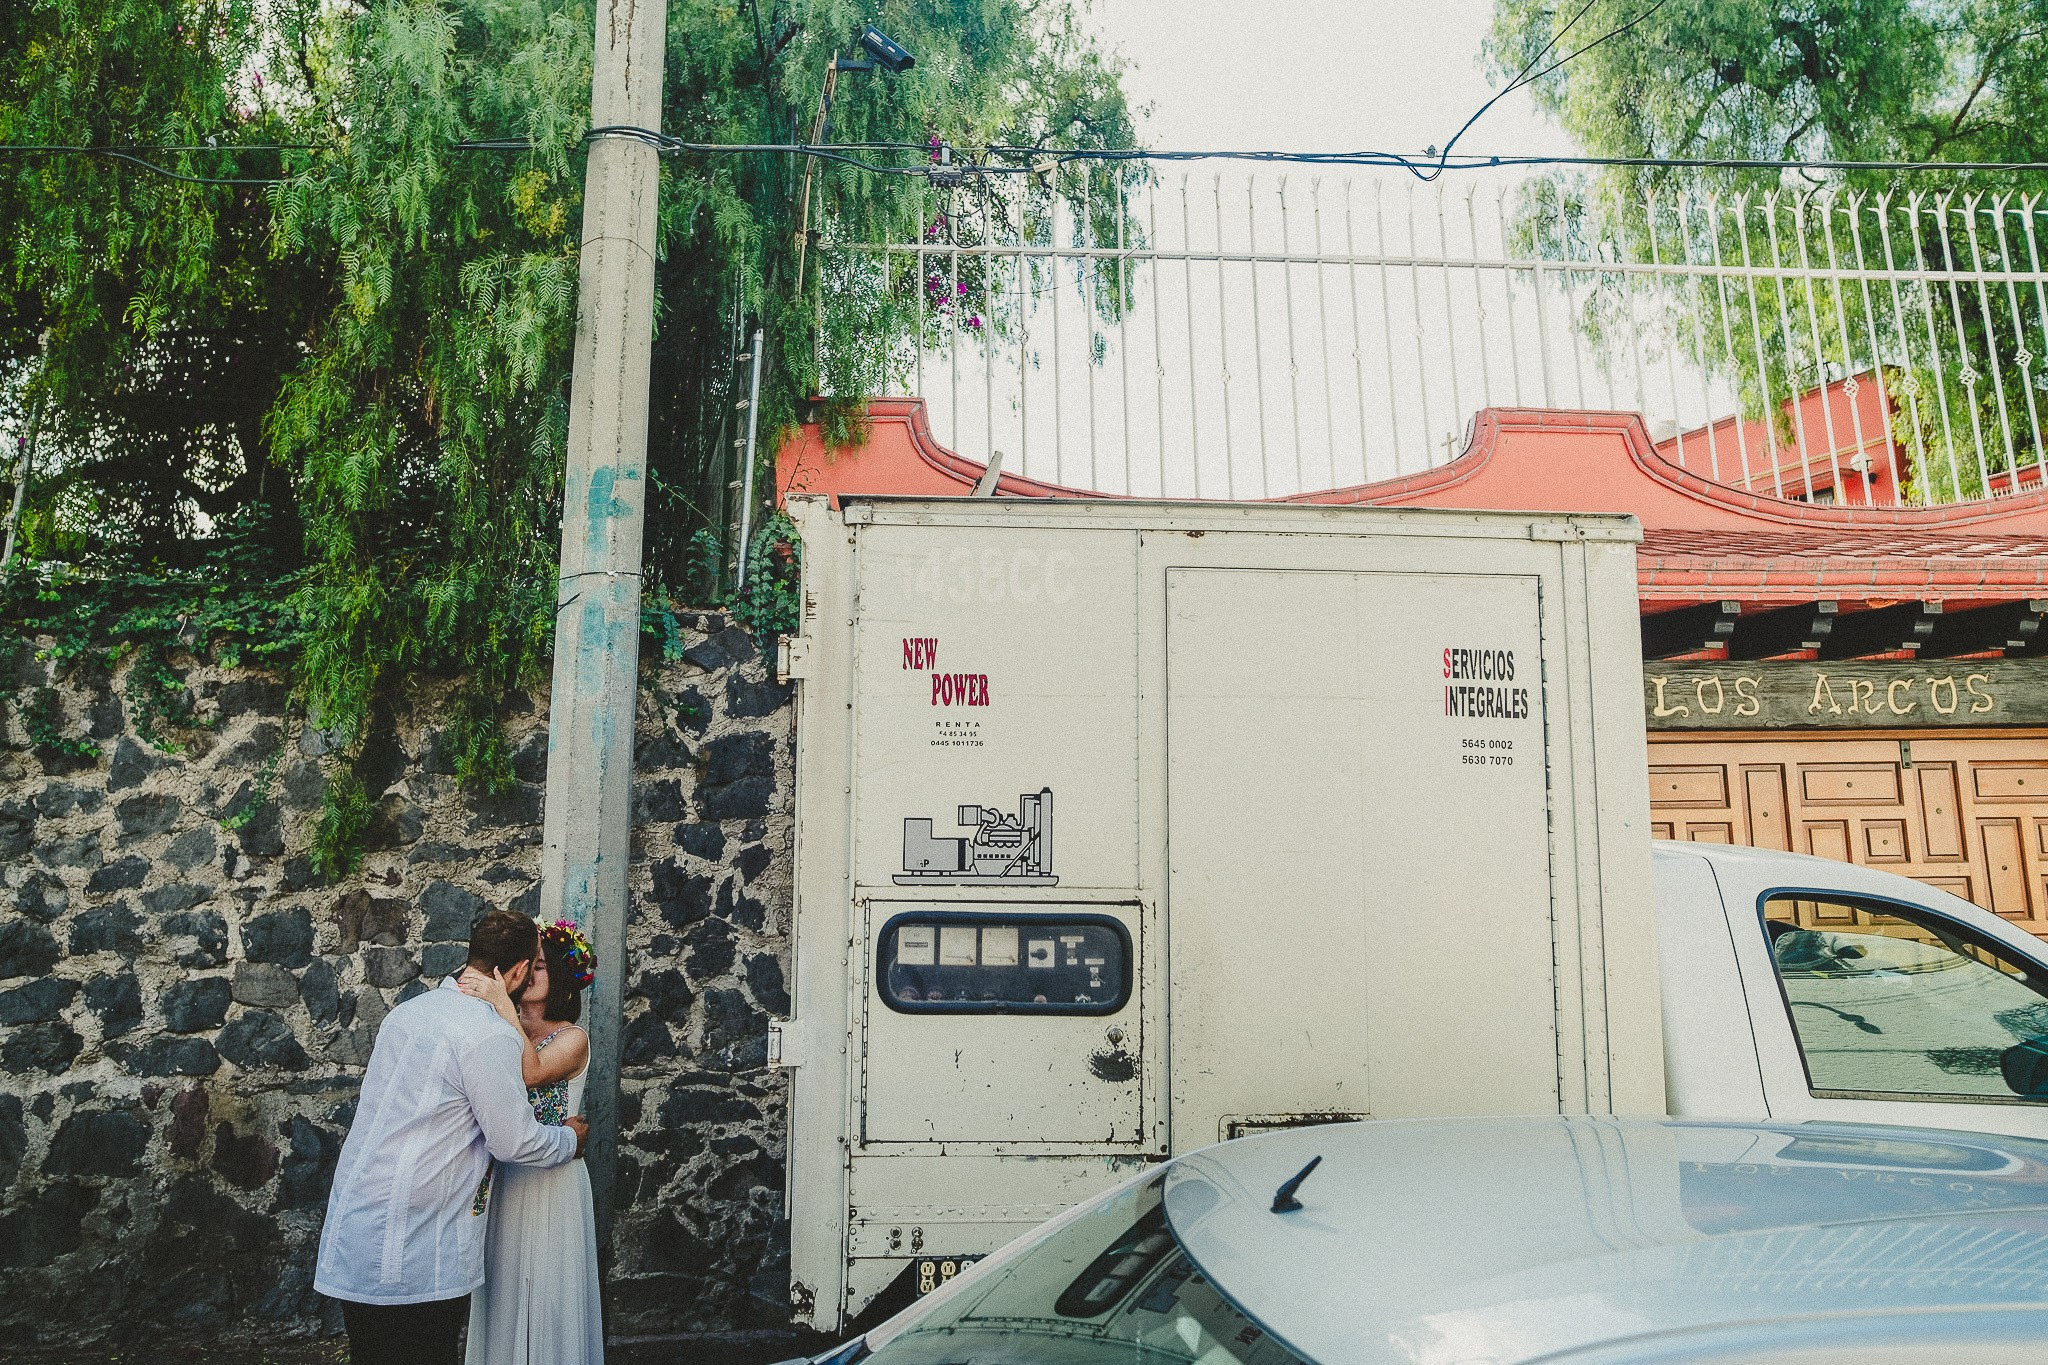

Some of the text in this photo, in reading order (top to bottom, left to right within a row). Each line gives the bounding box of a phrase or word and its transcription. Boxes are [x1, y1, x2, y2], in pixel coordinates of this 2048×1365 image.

[902, 637, 938, 670] NEW
[1443, 647, 1515, 681] SERVICIOS
[931, 673, 990, 706] POWER
[1445, 685, 1529, 719] INTEGRALES
[1650, 671, 1995, 718] LOS ARCOS
[1462, 739, 1513, 750] 5645 0002
[1462, 755, 1513, 766] 5630 7070
